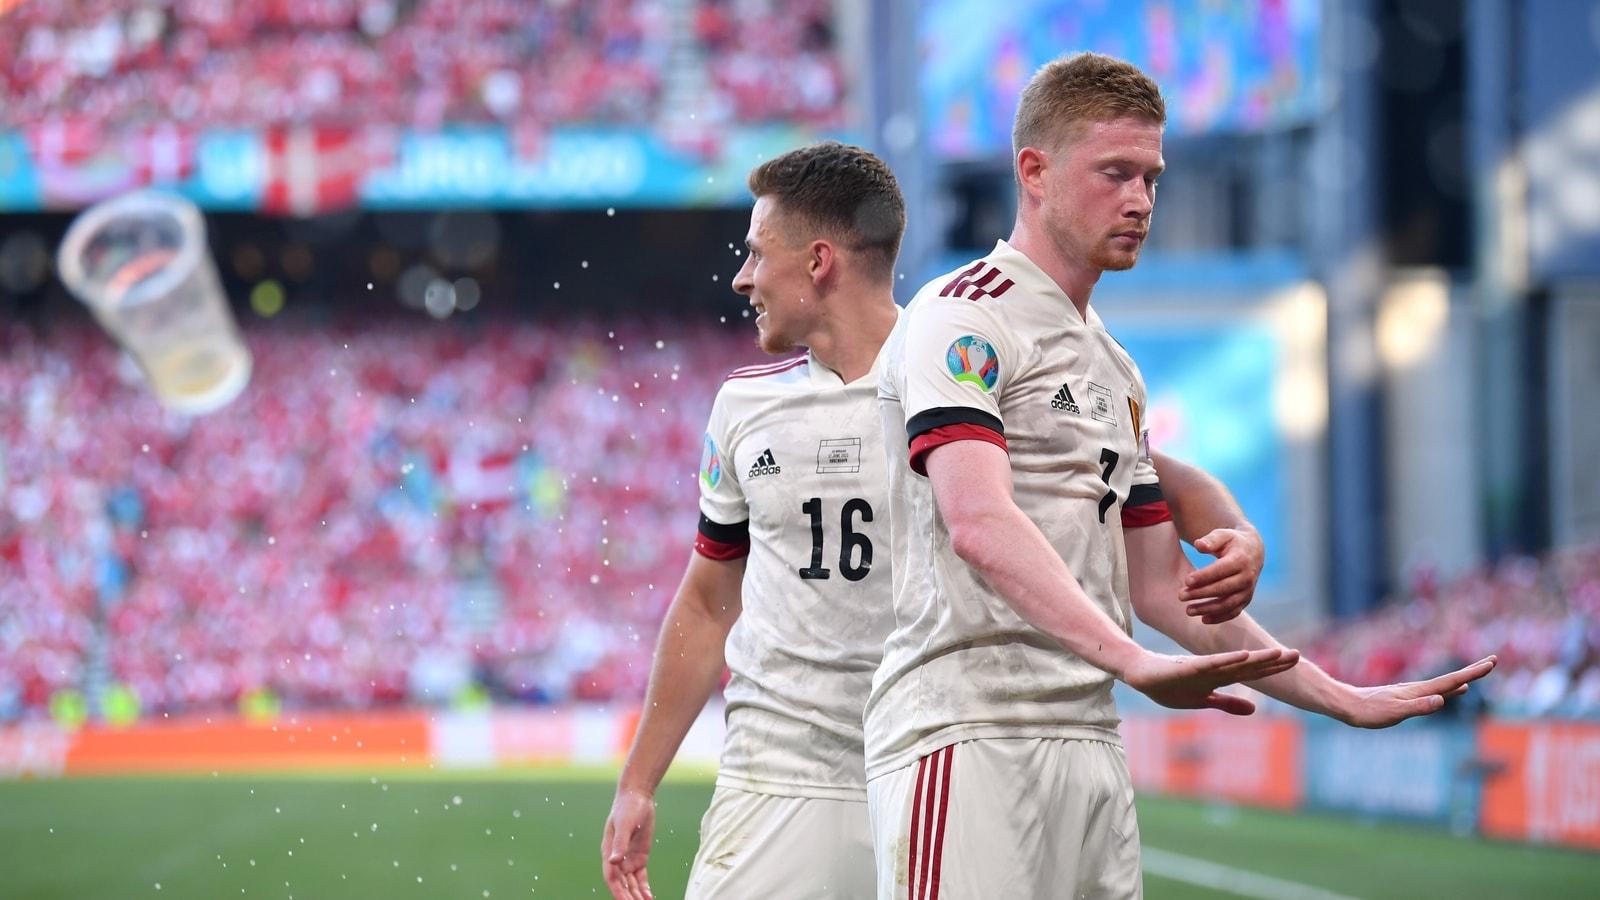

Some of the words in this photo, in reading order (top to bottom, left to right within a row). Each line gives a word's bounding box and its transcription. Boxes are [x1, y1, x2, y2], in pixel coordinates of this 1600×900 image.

[1051, 399, 1080, 415] adidas
[749, 465, 781, 478] adidas
[1098, 447, 1119, 524] 7
[799, 497, 874, 582] 16
